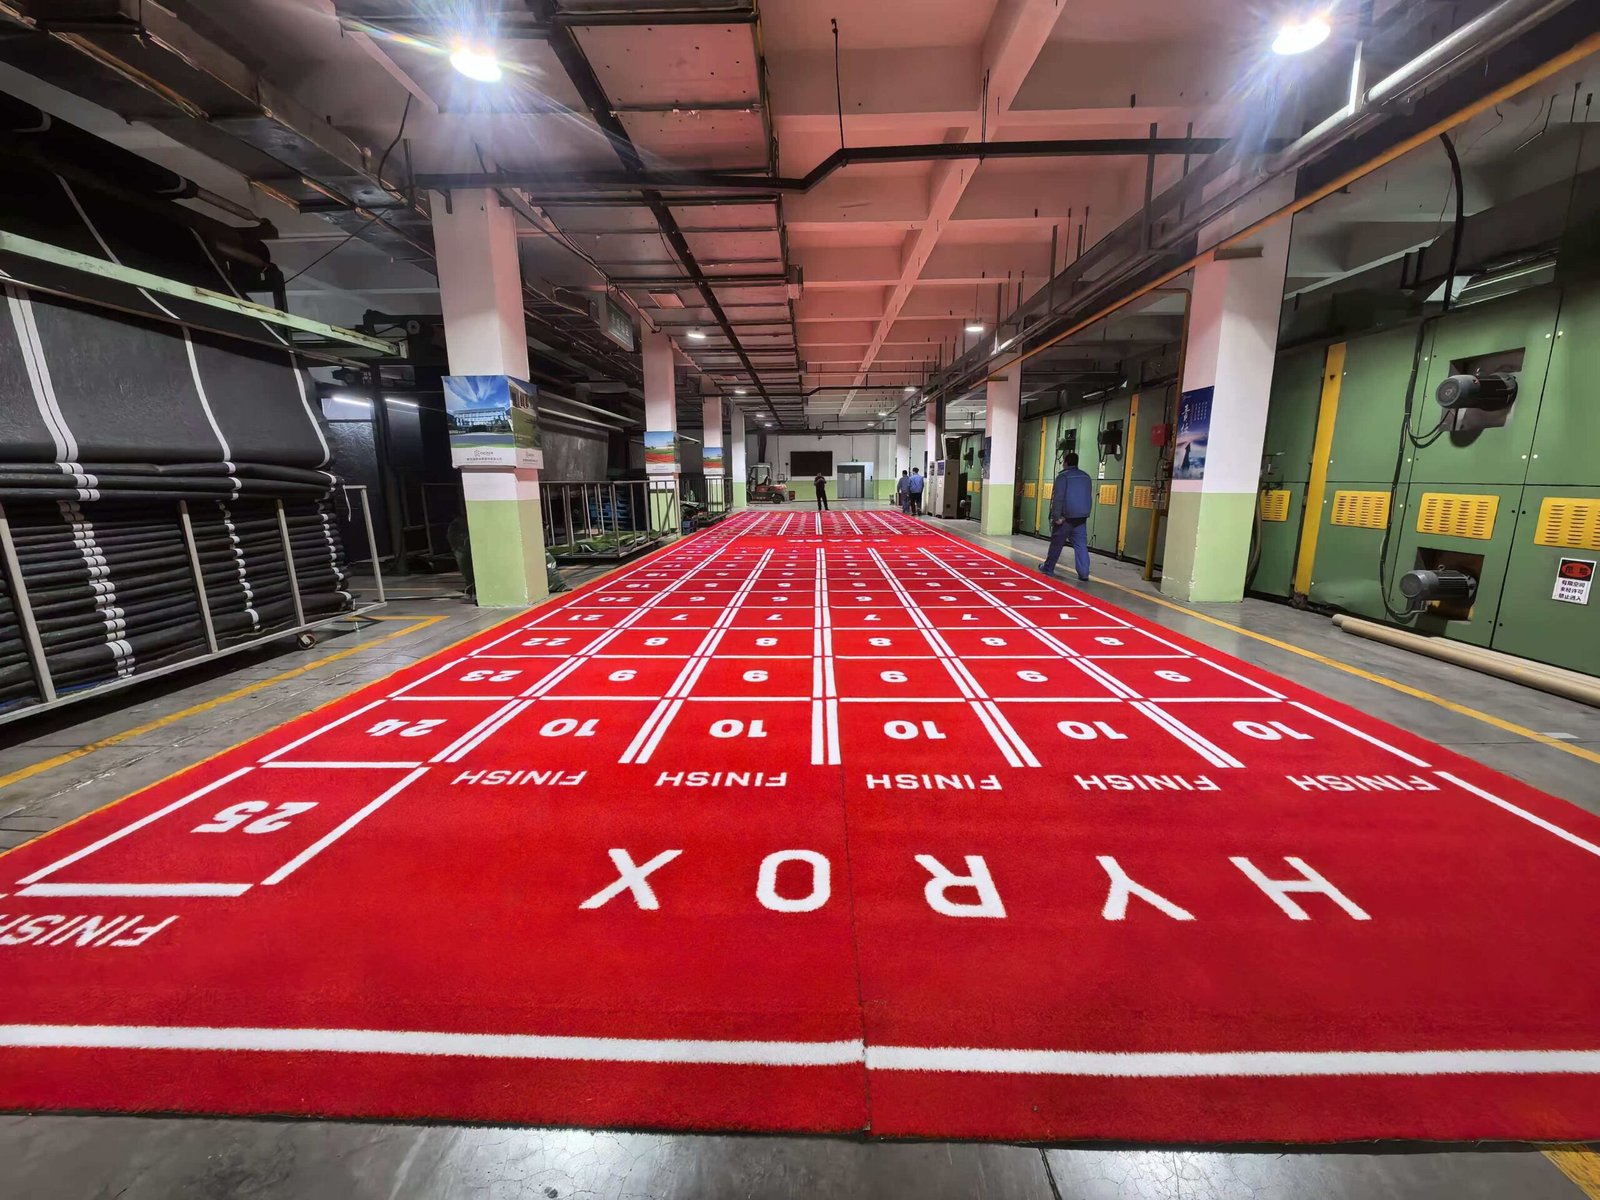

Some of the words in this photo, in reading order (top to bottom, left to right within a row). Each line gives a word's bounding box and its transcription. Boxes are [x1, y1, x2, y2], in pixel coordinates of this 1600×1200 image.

[522, 637, 571, 647] 22
[645, 637, 668, 647] 8
[756, 637, 778, 647] 8
[869, 637, 892, 647] 8
[981, 637, 1007, 646] 8
[1094, 636, 1124, 646] 8
[459, 670, 522, 682] 23
[608, 670, 637, 682] 9
[742, 670, 768, 682] 9
[880, 670, 908, 683] 9
[1016, 670, 1048, 683] 9
[1154, 670, 1191, 682] 9
[366, 719, 447, 737] 24
[539, 719, 600, 737] 10
[709, 719, 768, 738] 10
[883, 720, 946, 740] 10
[1057, 720, 1128, 740] 10
[1233, 721, 1314, 740] 10
[450, 770, 587, 785] FINISH
[654, 772, 787, 787] FINISH
[865, 774, 1003, 790] FINISH
[1073, 775, 1222, 791] FINISH
[1285, 775, 1441, 792] FINISH
[190, 800, 319, 833] 25
